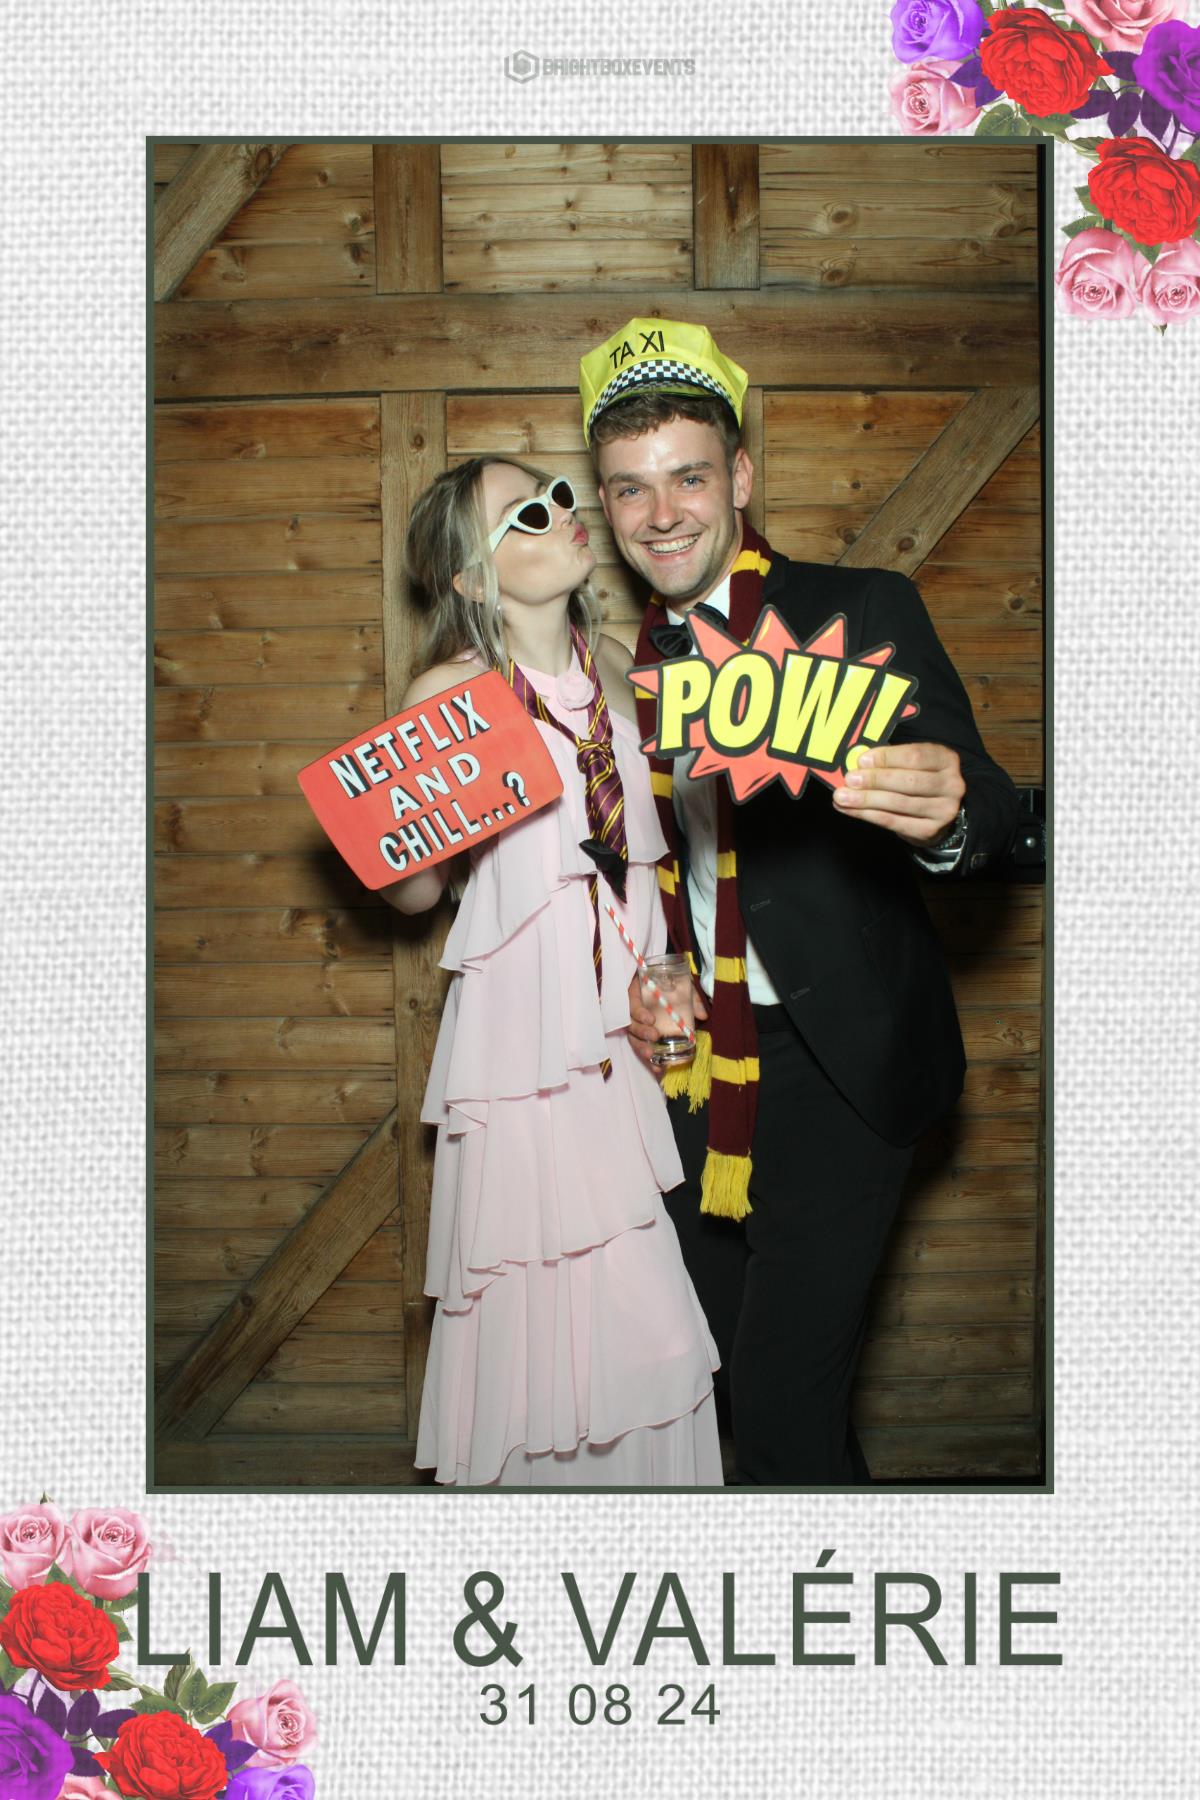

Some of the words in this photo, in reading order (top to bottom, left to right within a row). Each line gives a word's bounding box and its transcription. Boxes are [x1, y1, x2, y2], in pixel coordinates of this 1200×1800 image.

[609, 330, 665, 369] TAXI
[328, 689, 491, 799] NETFLIX
[658, 652, 912, 772] POW!
[388, 752, 482, 820] AND
